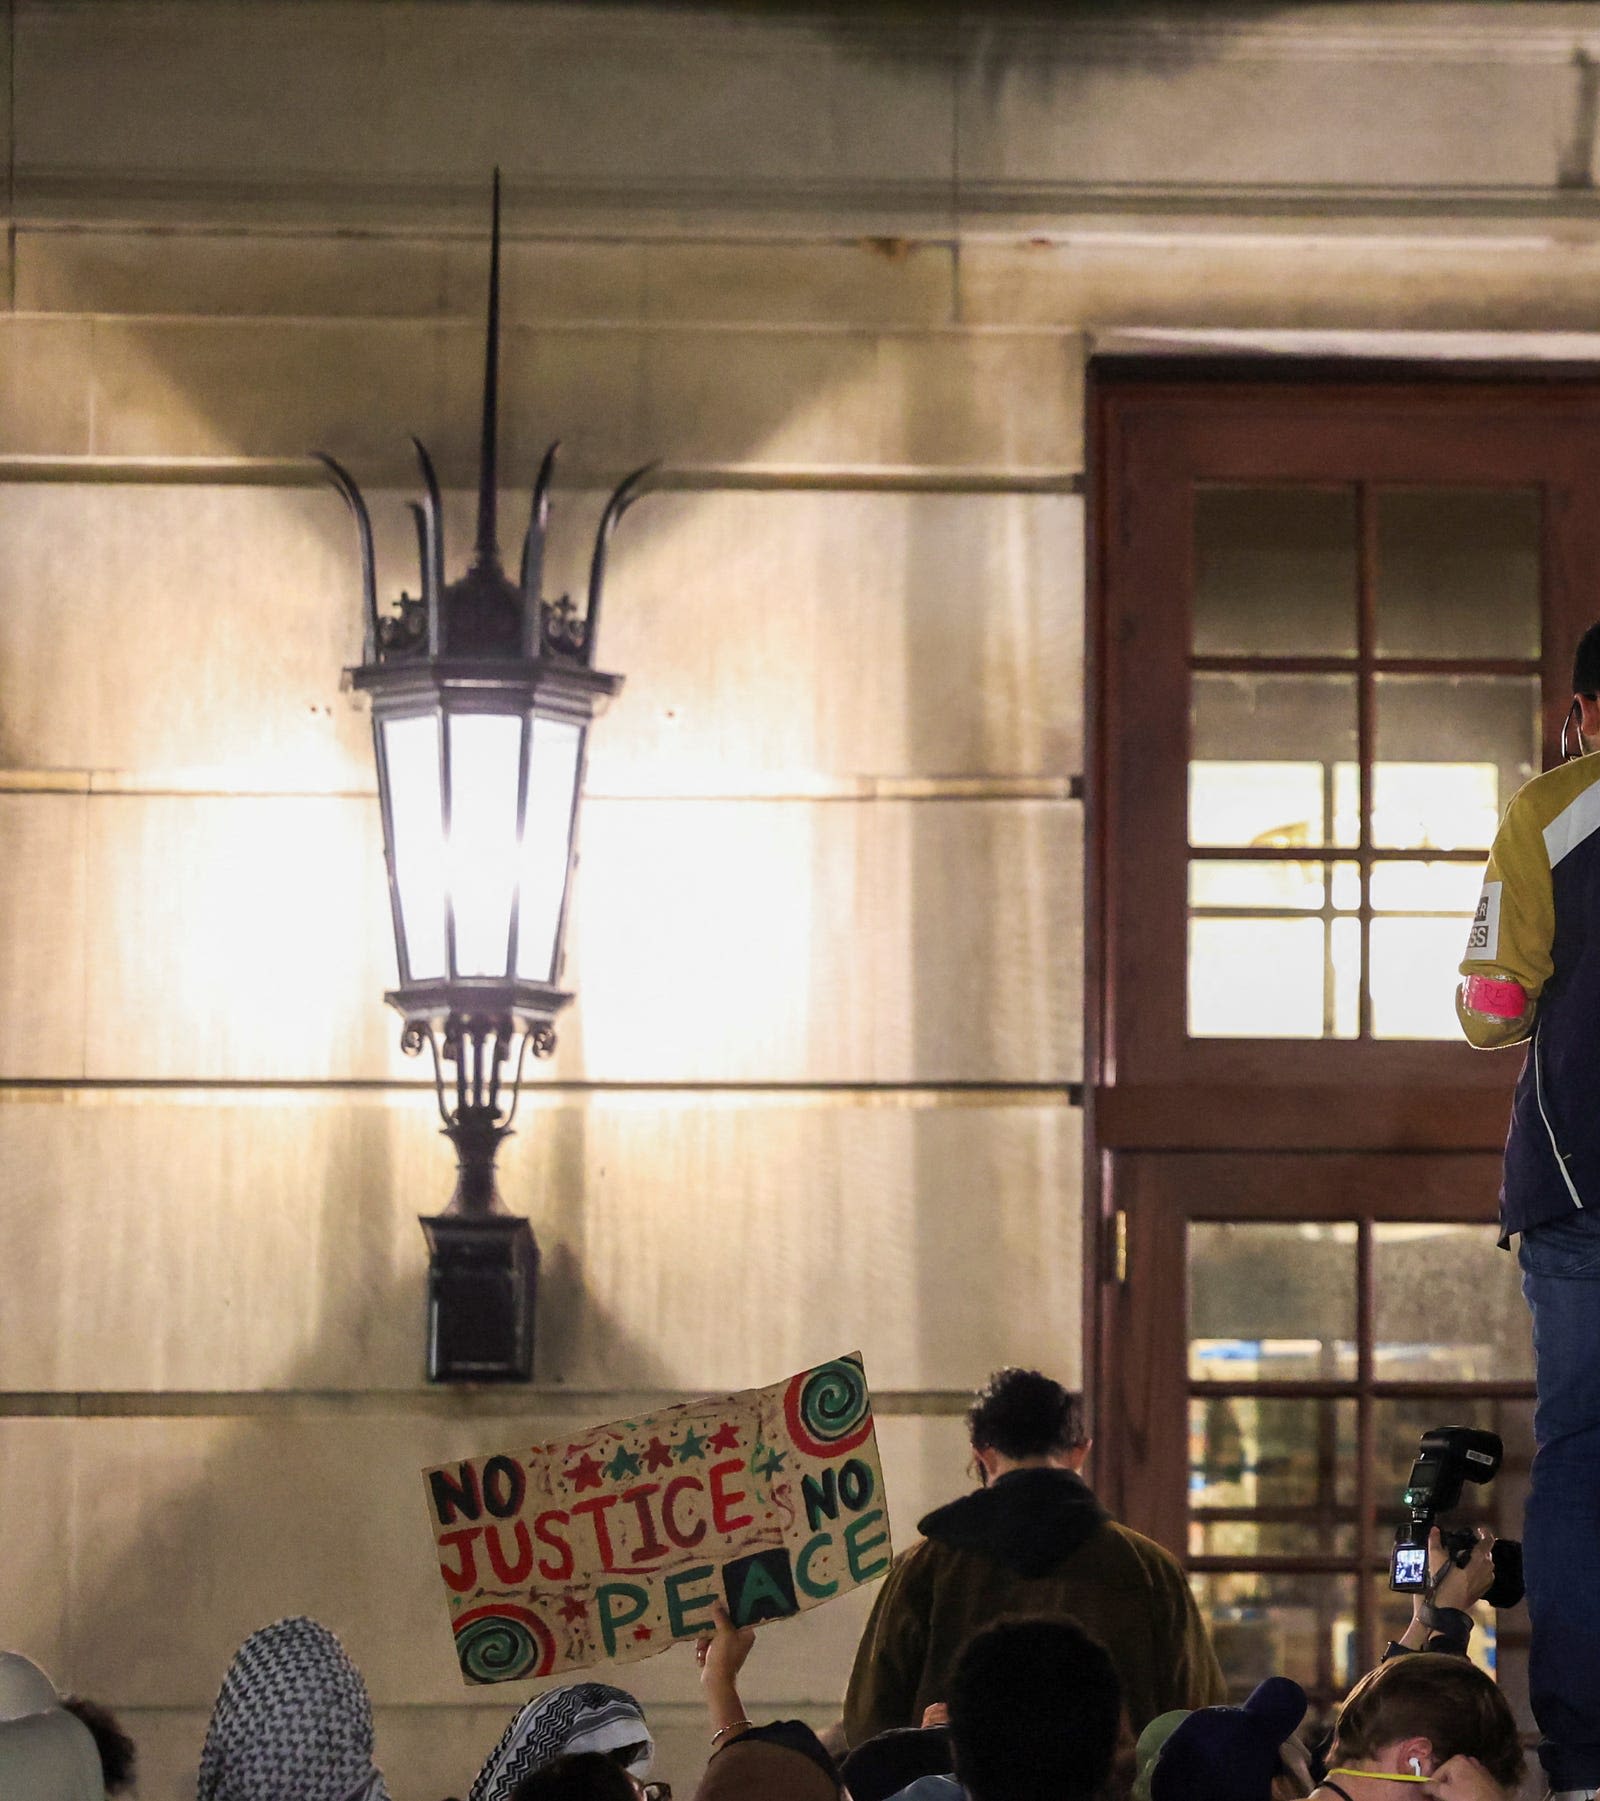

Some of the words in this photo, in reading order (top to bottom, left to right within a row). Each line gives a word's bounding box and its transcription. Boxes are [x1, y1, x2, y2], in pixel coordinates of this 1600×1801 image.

[429, 1454, 527, 1525] NO
[438, 1458, 754, 1592] JUSTICE
[801, 1458, 875, 1532] NO
[594, 1508, 890, 1658] PEACE
